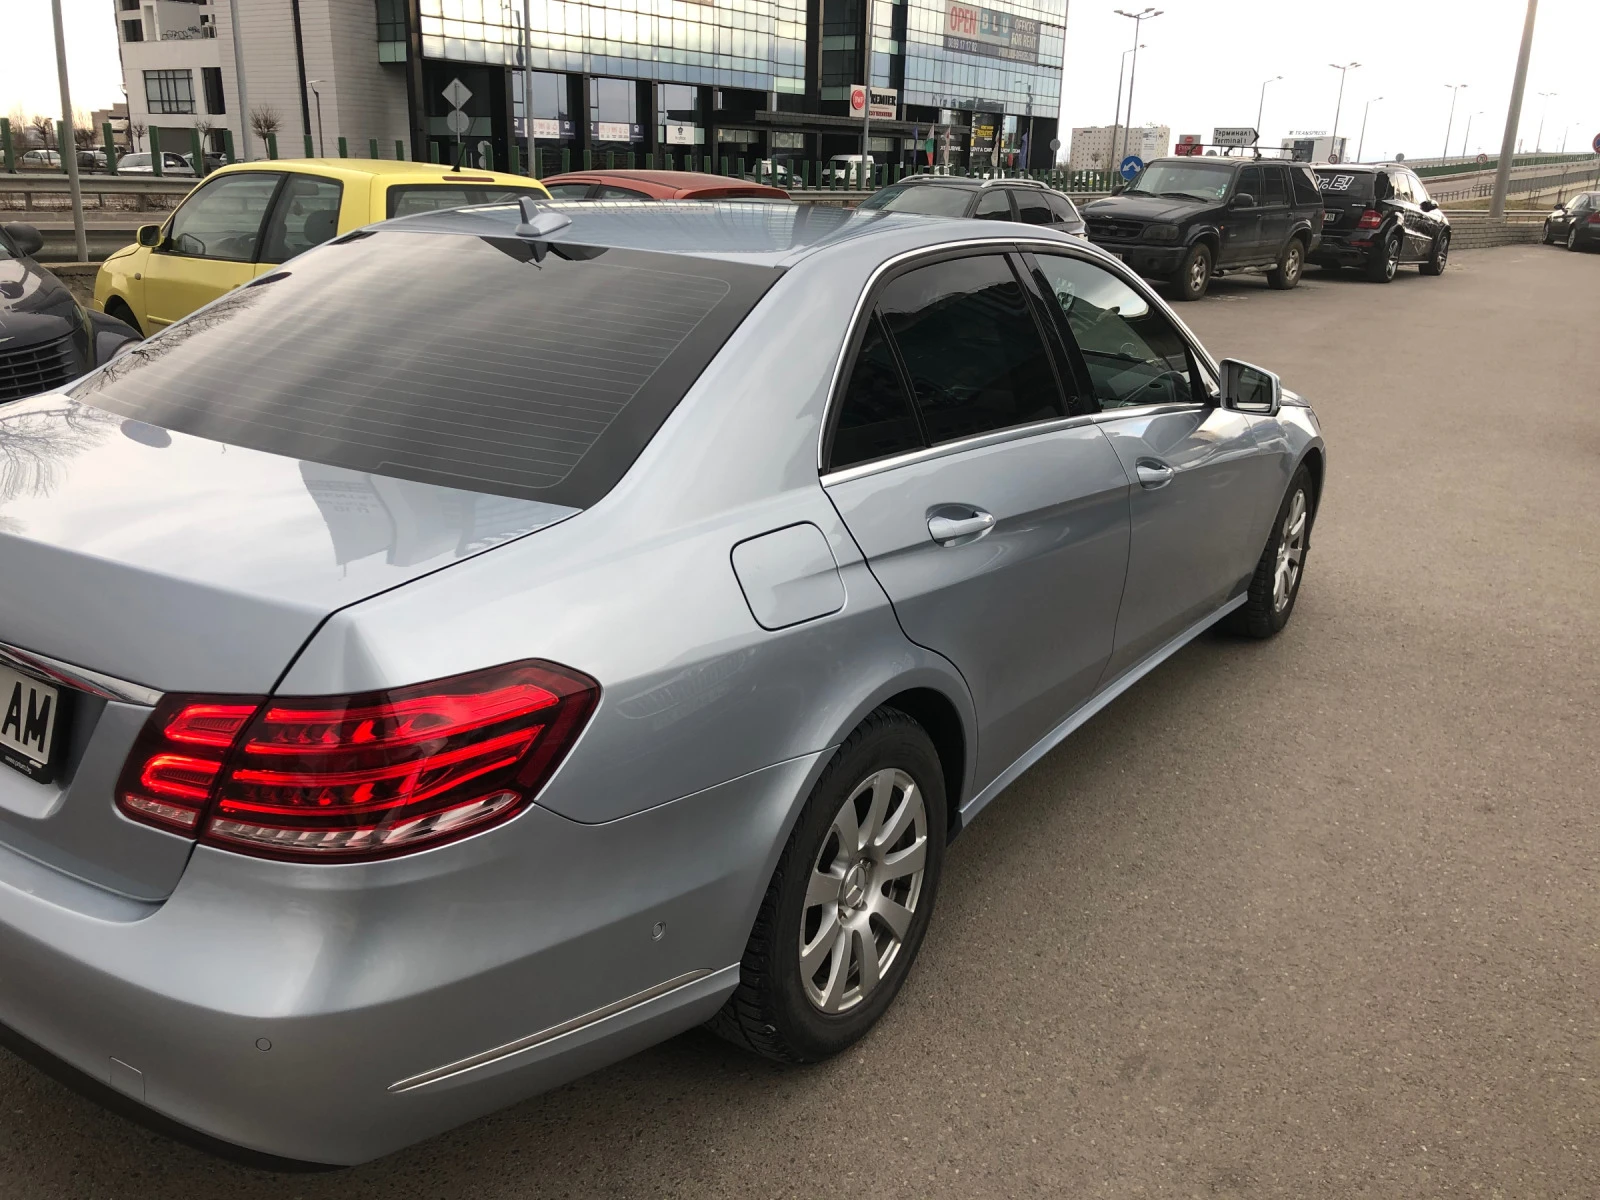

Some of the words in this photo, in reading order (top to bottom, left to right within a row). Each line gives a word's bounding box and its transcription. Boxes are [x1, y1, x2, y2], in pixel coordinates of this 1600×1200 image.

[950, 6, 978, 35] OPEN
[1011, 32, 1022, 47] FOR
[1023, 34, 1036, 49] RENT
[1215, 130, 1247, 138] Терминал
[2, 681, 51, 753] AM
